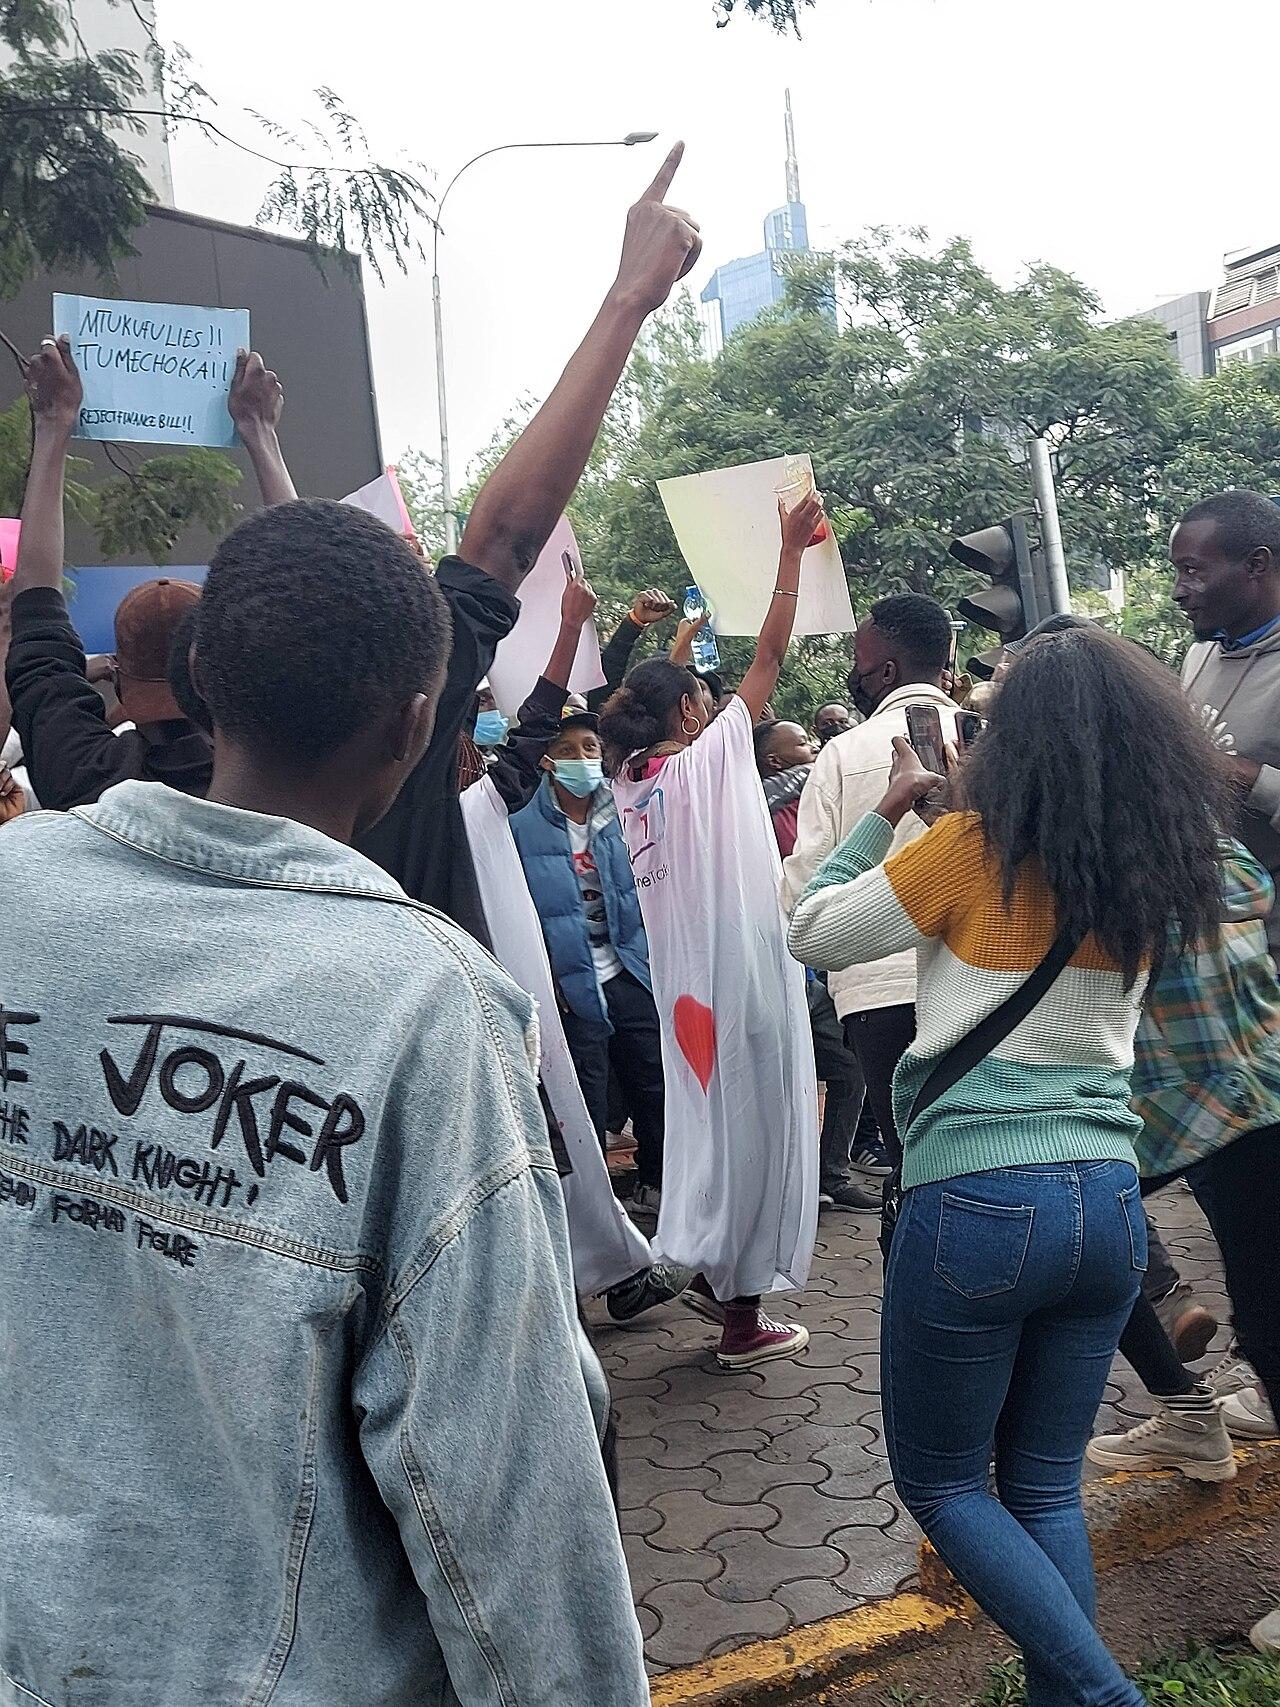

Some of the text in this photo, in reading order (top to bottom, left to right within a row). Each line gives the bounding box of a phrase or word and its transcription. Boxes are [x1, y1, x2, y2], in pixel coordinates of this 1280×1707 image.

[77, 343, 228, 392] TUMECHOKA!!
[0, 1101, 30, 1145] HE
[53, 1120, 119, 1177] DARK
[100, 1014, 366, 1204] JOKER
